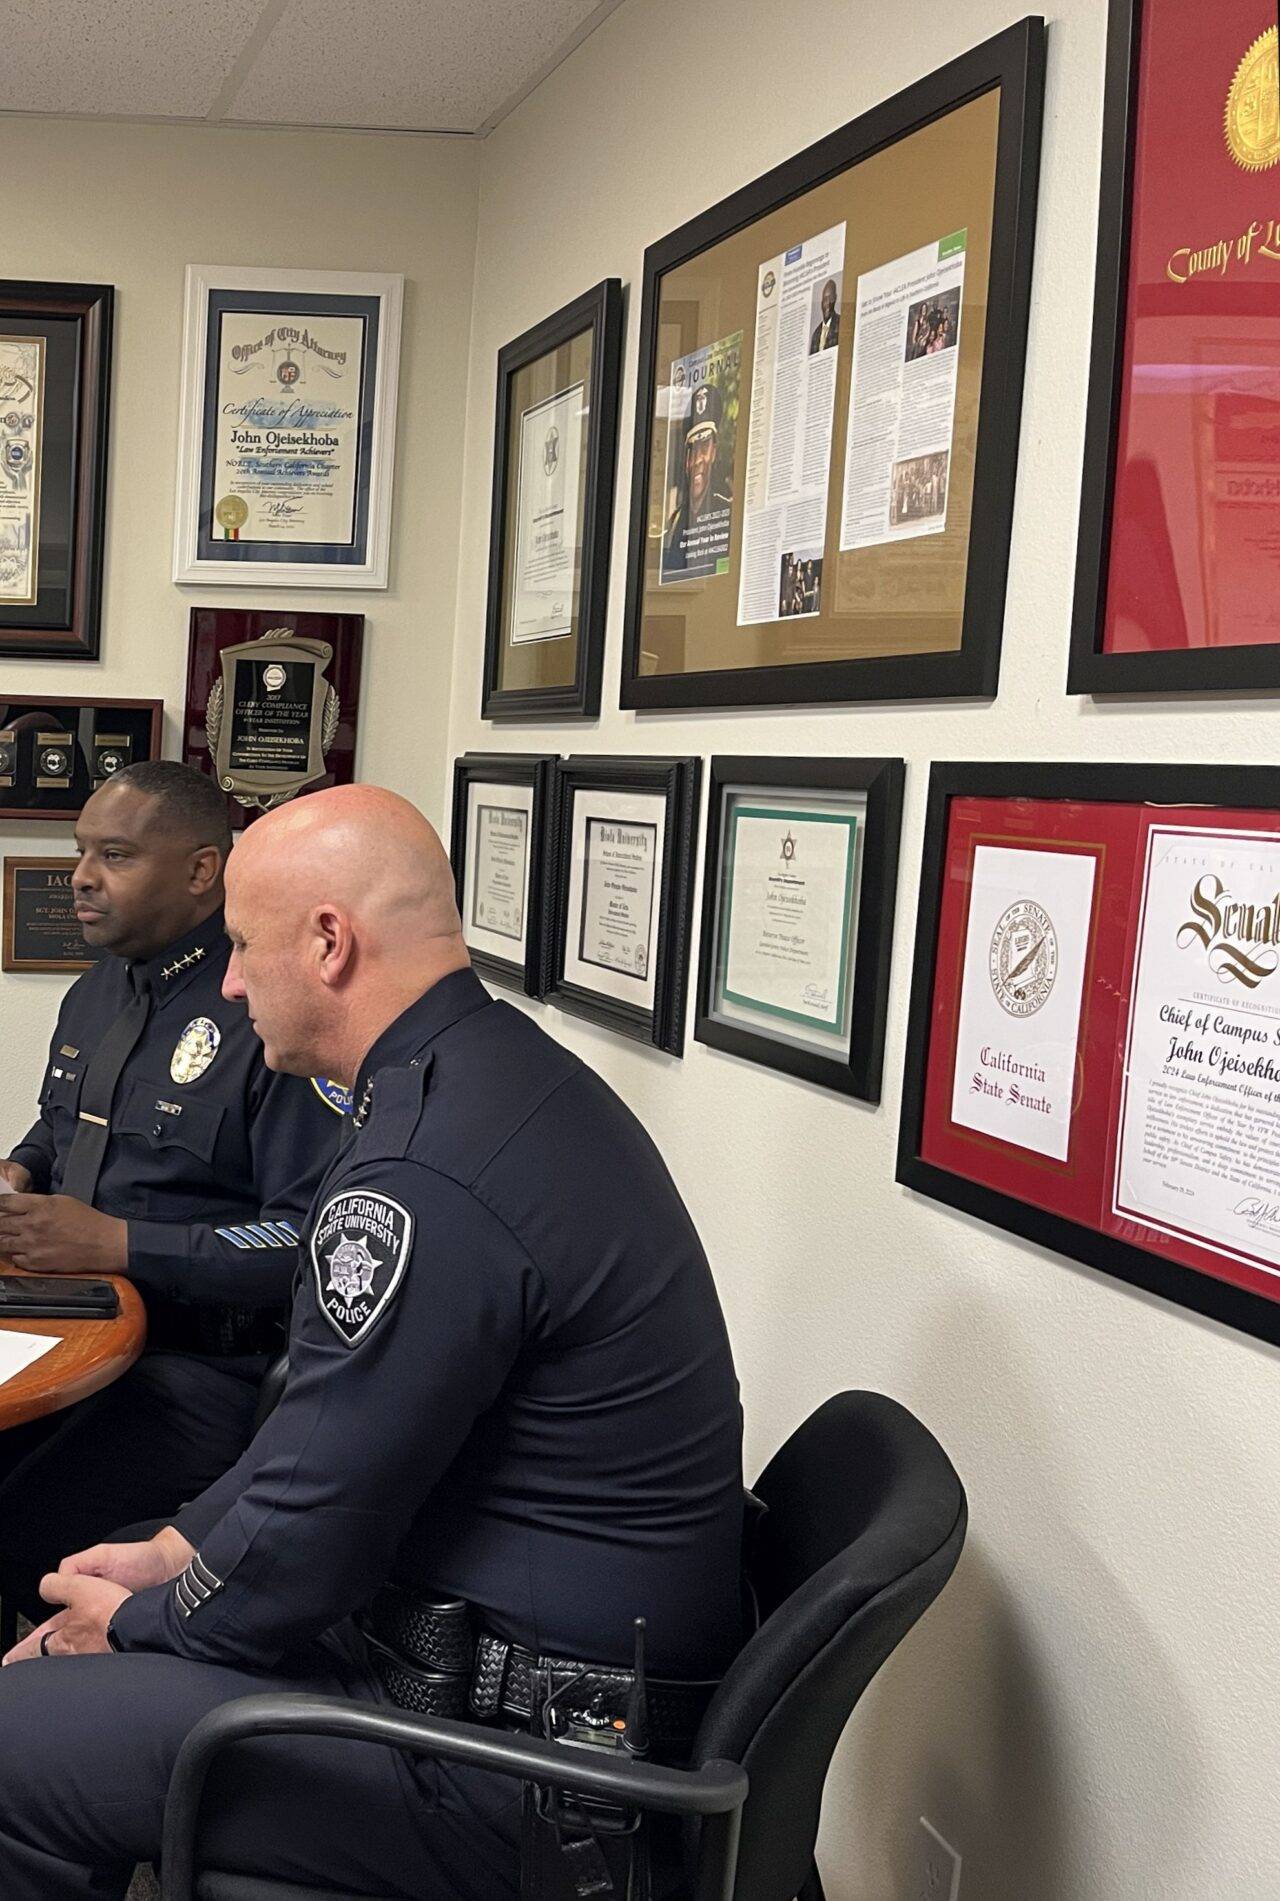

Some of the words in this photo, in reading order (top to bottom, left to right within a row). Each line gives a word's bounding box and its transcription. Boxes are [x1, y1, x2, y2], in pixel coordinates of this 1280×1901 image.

[1167, 239, 1234, 283] County
[1236, 220, 1263, 265] of
[232, 340, 263, 362] Office
[264, 328, 276, 347] of
[277, 326, 300, 343] City
[300, 328, 347, 365] Attorney
[688, 351, 738, 388] JOURNAL
[222, 397, 277, 428] Certificate
[290, 402, 353, 428] Appreciation
[230, 430, 261, 443] John
[266, 431, 339, 447] Ojeisekhoba
[261, 702, 308, 710] COMPLIANCE
[616, 828, 648, 852] University
[1159, 1004, 1193, 1032] Chief
[1195, 1013, 1210, 1036] of
[1213, 1015, 1268, 1045] Campus
[980, 1046, 1046, 1083] California
[1165, 1036, 1203, 1064] John
[969, 1072, 1004, 1100] State
[1005, 1083, 1052, 1115] Senate
[1162, 1064, 1179, 1078] 2024
[1197, 1074, 1237, 1092] Enforcement
[1238, 1084, 1263, 1099] Officer
[328, 1199, 395, 1231] CALIFORNIA
[317, 1218, 344, 1246] STATE
[344, 1215, 400, 1255] UNIVERSITY
[326, 1297, 372, 1325] POLICE
